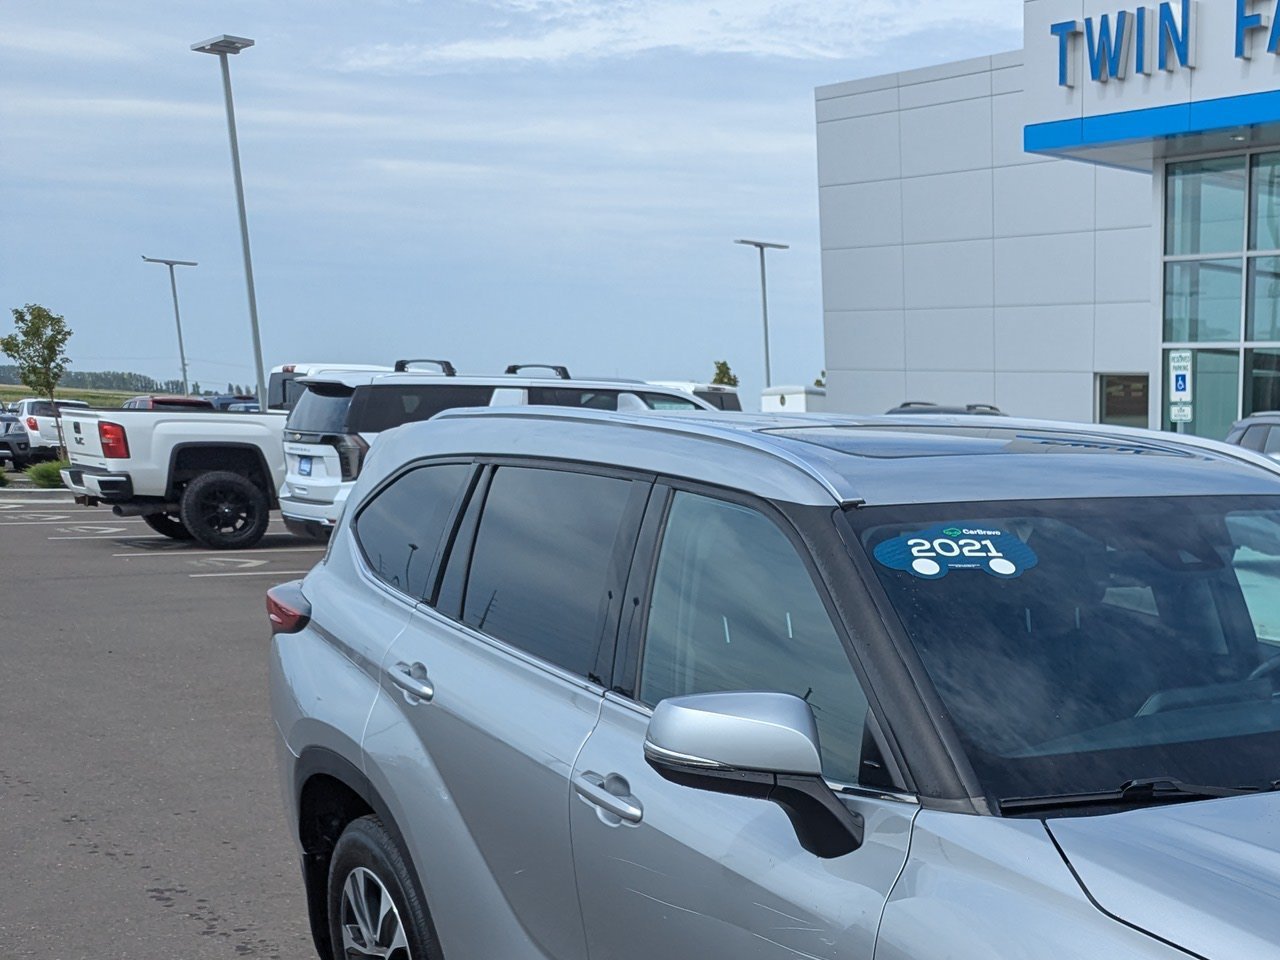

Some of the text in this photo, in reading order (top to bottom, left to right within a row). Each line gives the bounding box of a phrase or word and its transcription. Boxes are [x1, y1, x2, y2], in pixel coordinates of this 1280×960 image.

[1051, 0, 1196, 88] TWIN
[962, 528, 1001, 536] CarBravo
[907, 538, 1003, 557] 2021
